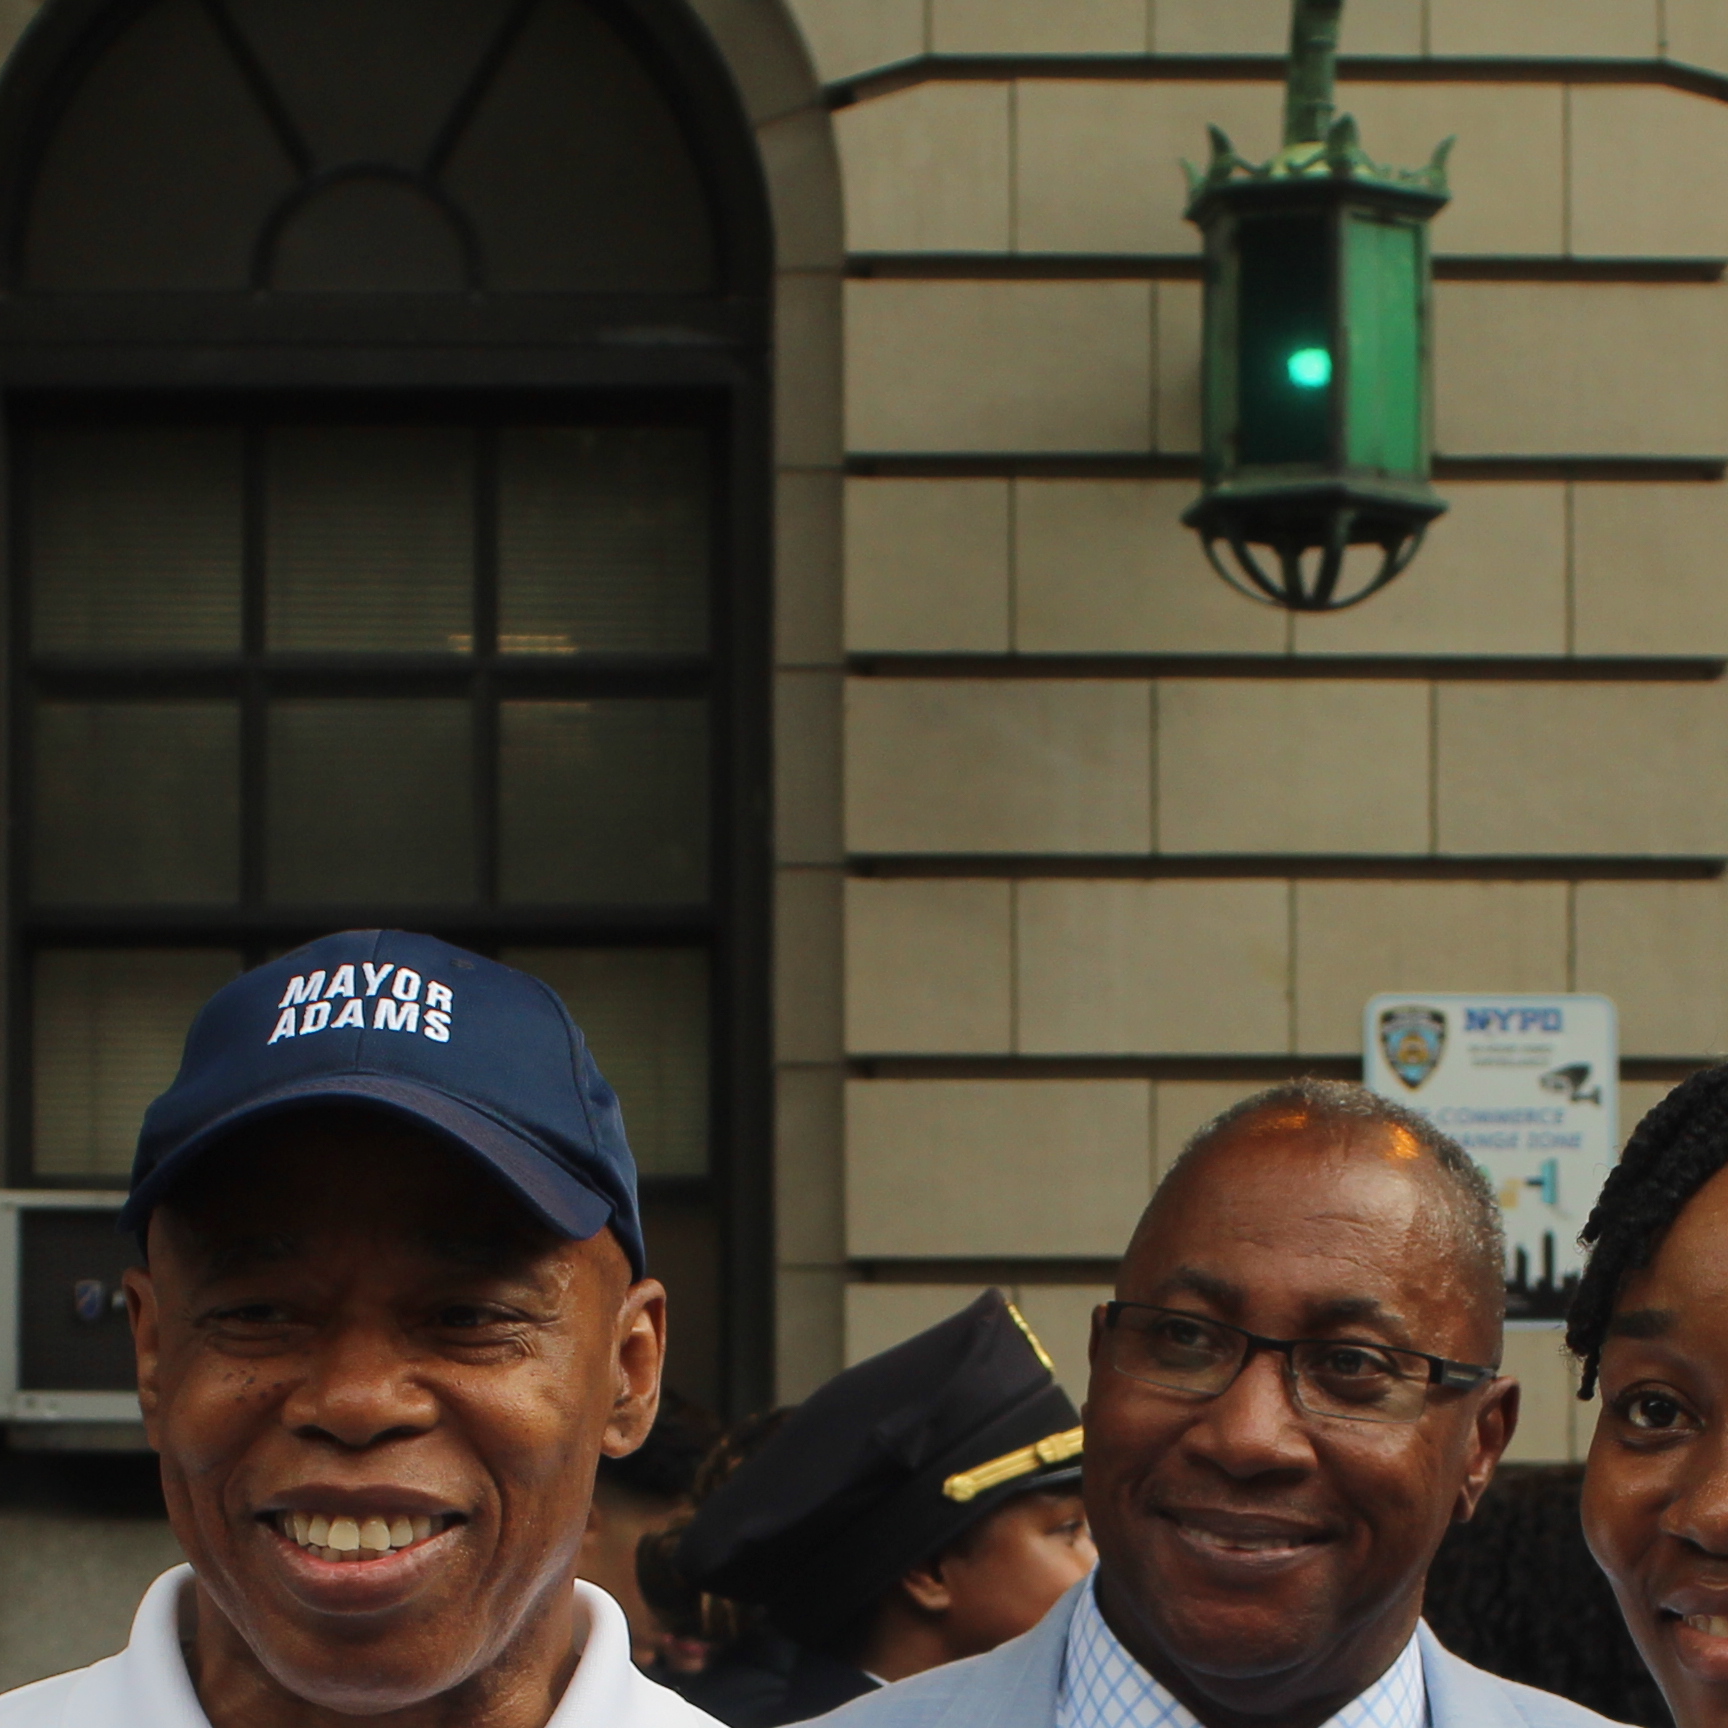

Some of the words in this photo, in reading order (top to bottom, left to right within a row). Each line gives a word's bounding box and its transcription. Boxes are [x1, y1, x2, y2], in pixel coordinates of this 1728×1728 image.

[278, 962, 454, 1014] MAYOR
[267, 998, 453, 1045] ADAMS
[1465, 1007, 1563, 1031] NYPD
